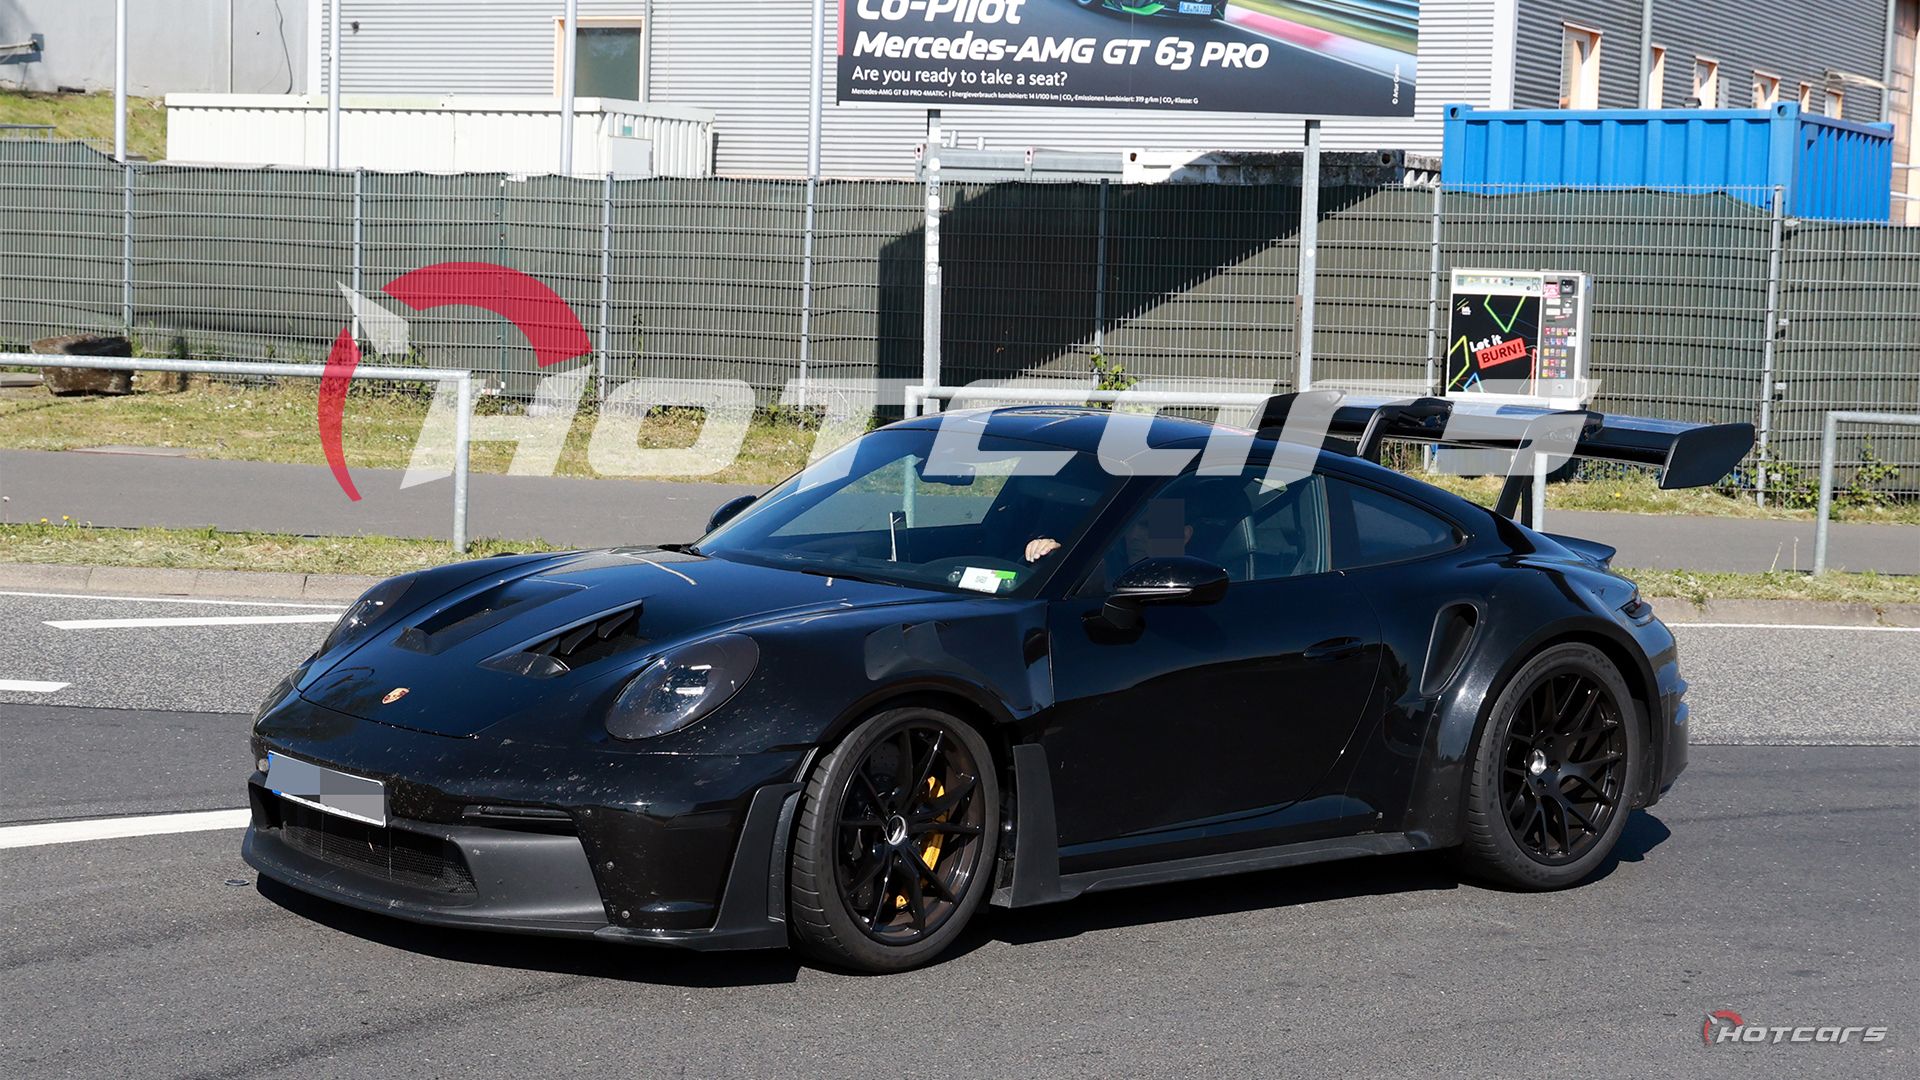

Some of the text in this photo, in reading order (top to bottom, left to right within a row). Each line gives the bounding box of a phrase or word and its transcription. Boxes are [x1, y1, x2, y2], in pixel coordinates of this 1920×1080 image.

[856, 0, 1026, 24] Co-Pilot
[852, 31, 1270, 71] Mercedes-AMG GT 63 PRO
[852, 66, 1068, 87] Are you ready to take a seat?
[851, 88, 893, 96] Mercedes-AMG
[1491, 334, 1503, 346] it
[1481, 343, 1523, 363] BURN!
